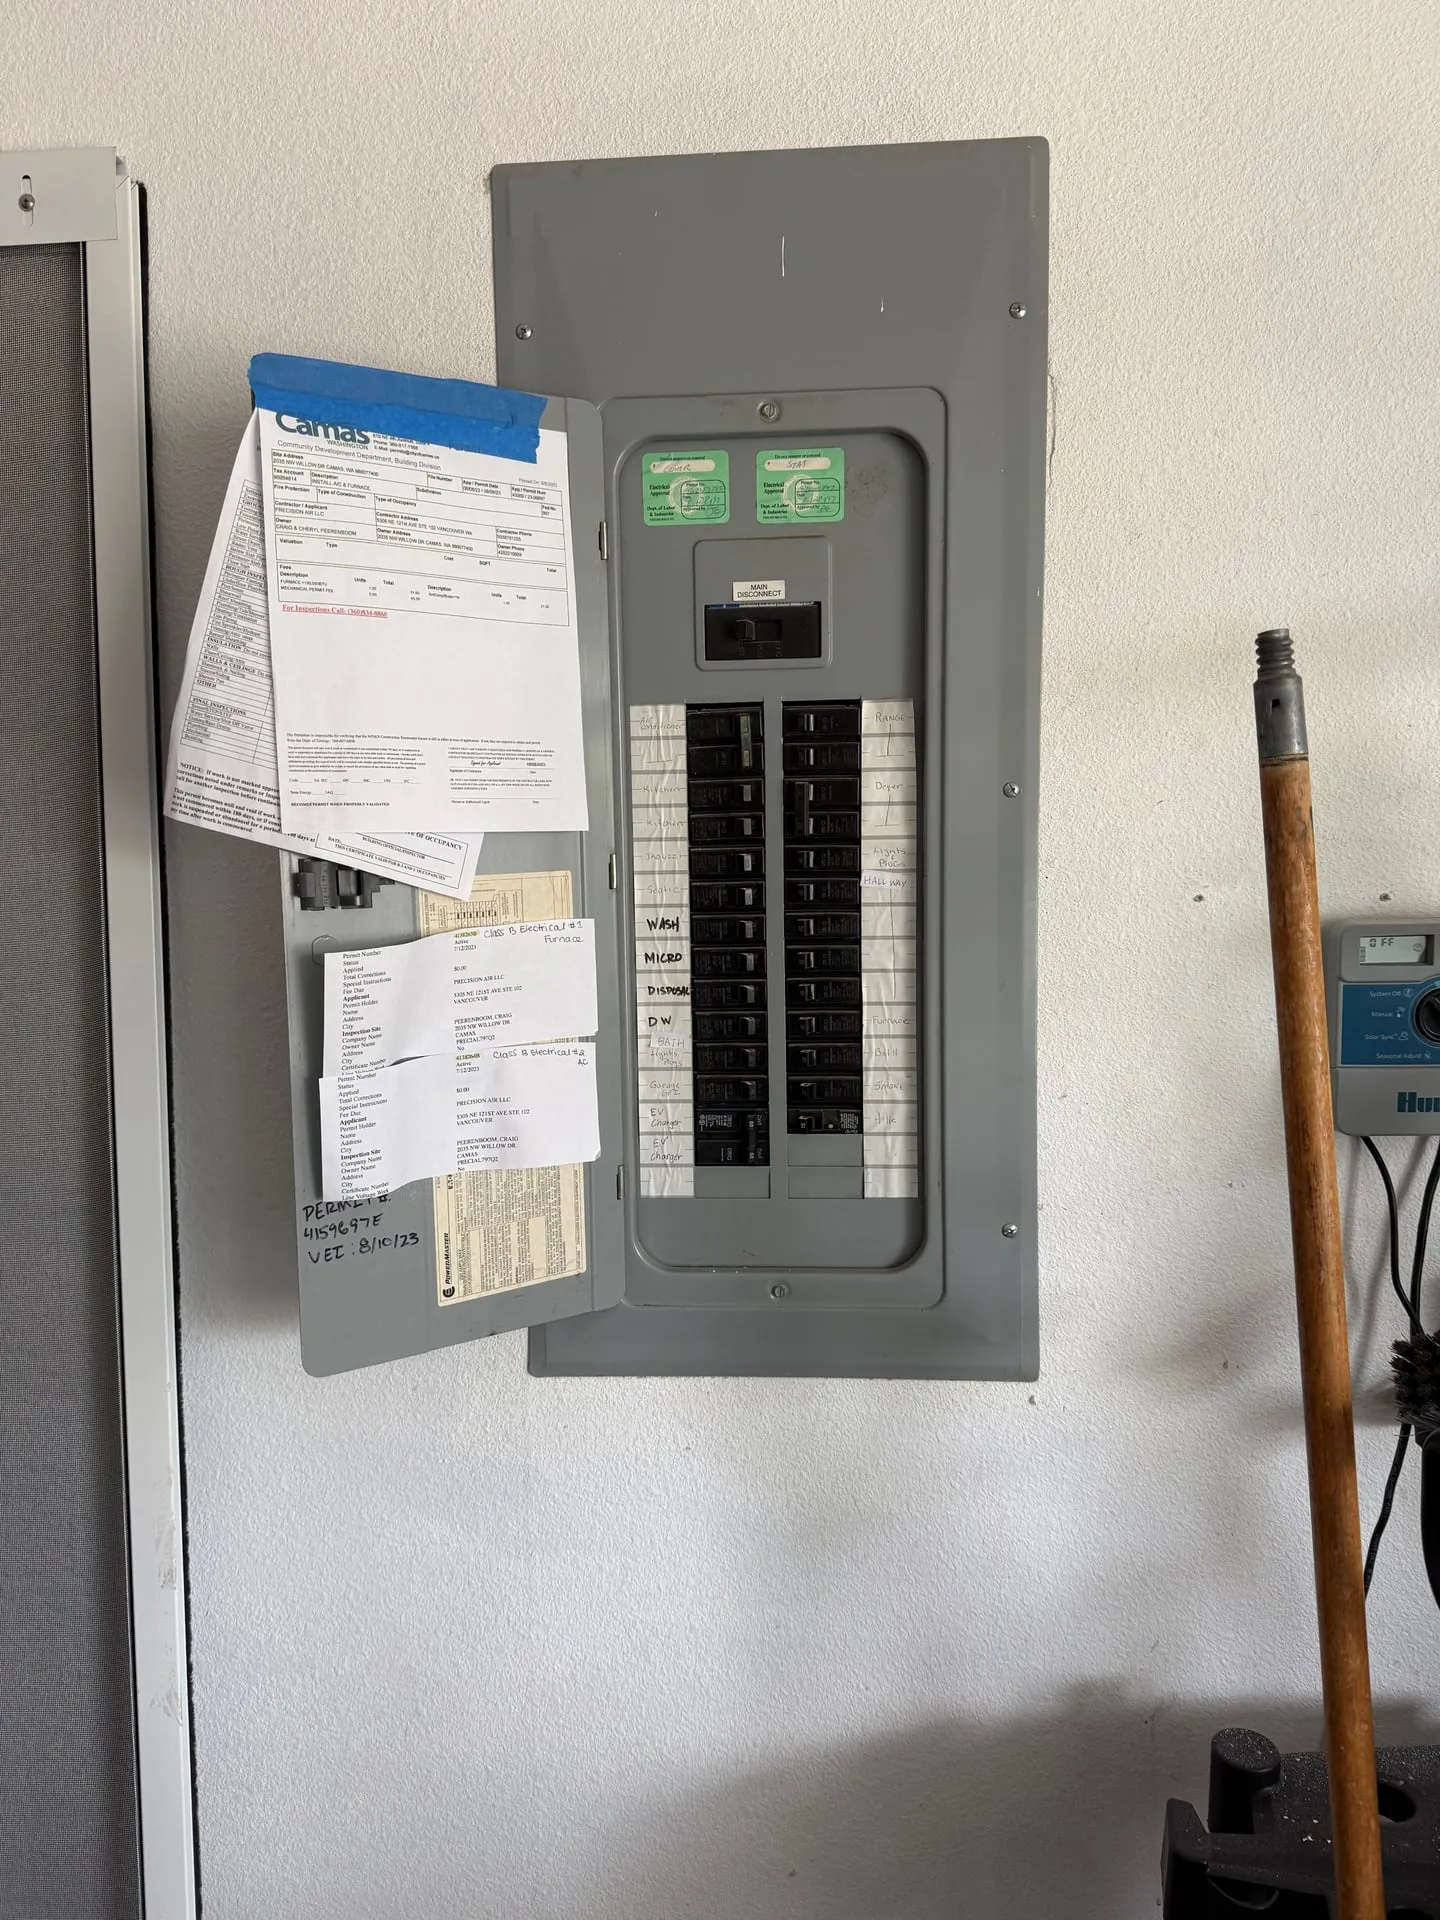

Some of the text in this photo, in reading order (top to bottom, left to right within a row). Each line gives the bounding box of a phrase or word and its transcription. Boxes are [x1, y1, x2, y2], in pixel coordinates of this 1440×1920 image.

[315, 445, 356, 458] Development
[737, 590, 781, 598] DISCONNECT
[864, 876, 887, 886] HALL
[647, 916, 680, 932] WASH
[483, 928, 505, 939] Class
[509, 926, 517, 936] B
[519, 921, 567, 933] Electrical
[544, 935, 584, 945] Furnace
[1369, 937, 1395, 948] OFF
[644, 952, 682, 964] MICRO
[647, 985, 690, 996] DISPOSAL
[1369, 989, 1401, 998] System Off
[1371, 1010, 1393, 1018] Manual
[492, 1049, 517, 1059] Class
[531, 1047, 571, 1057] Electrical
[1402, 1052, 1422, 1060] Adjust
[650, 1080, 681, 1091] Garage
[650, 1108, 664, 1116] EV
[650, 1119, 682, 1130] Charger
[653, 1136, 669, 1148] EV
[650, 1152, 683, 1164] Charger
[359, 1232, 420, 1254] 8/10/23
